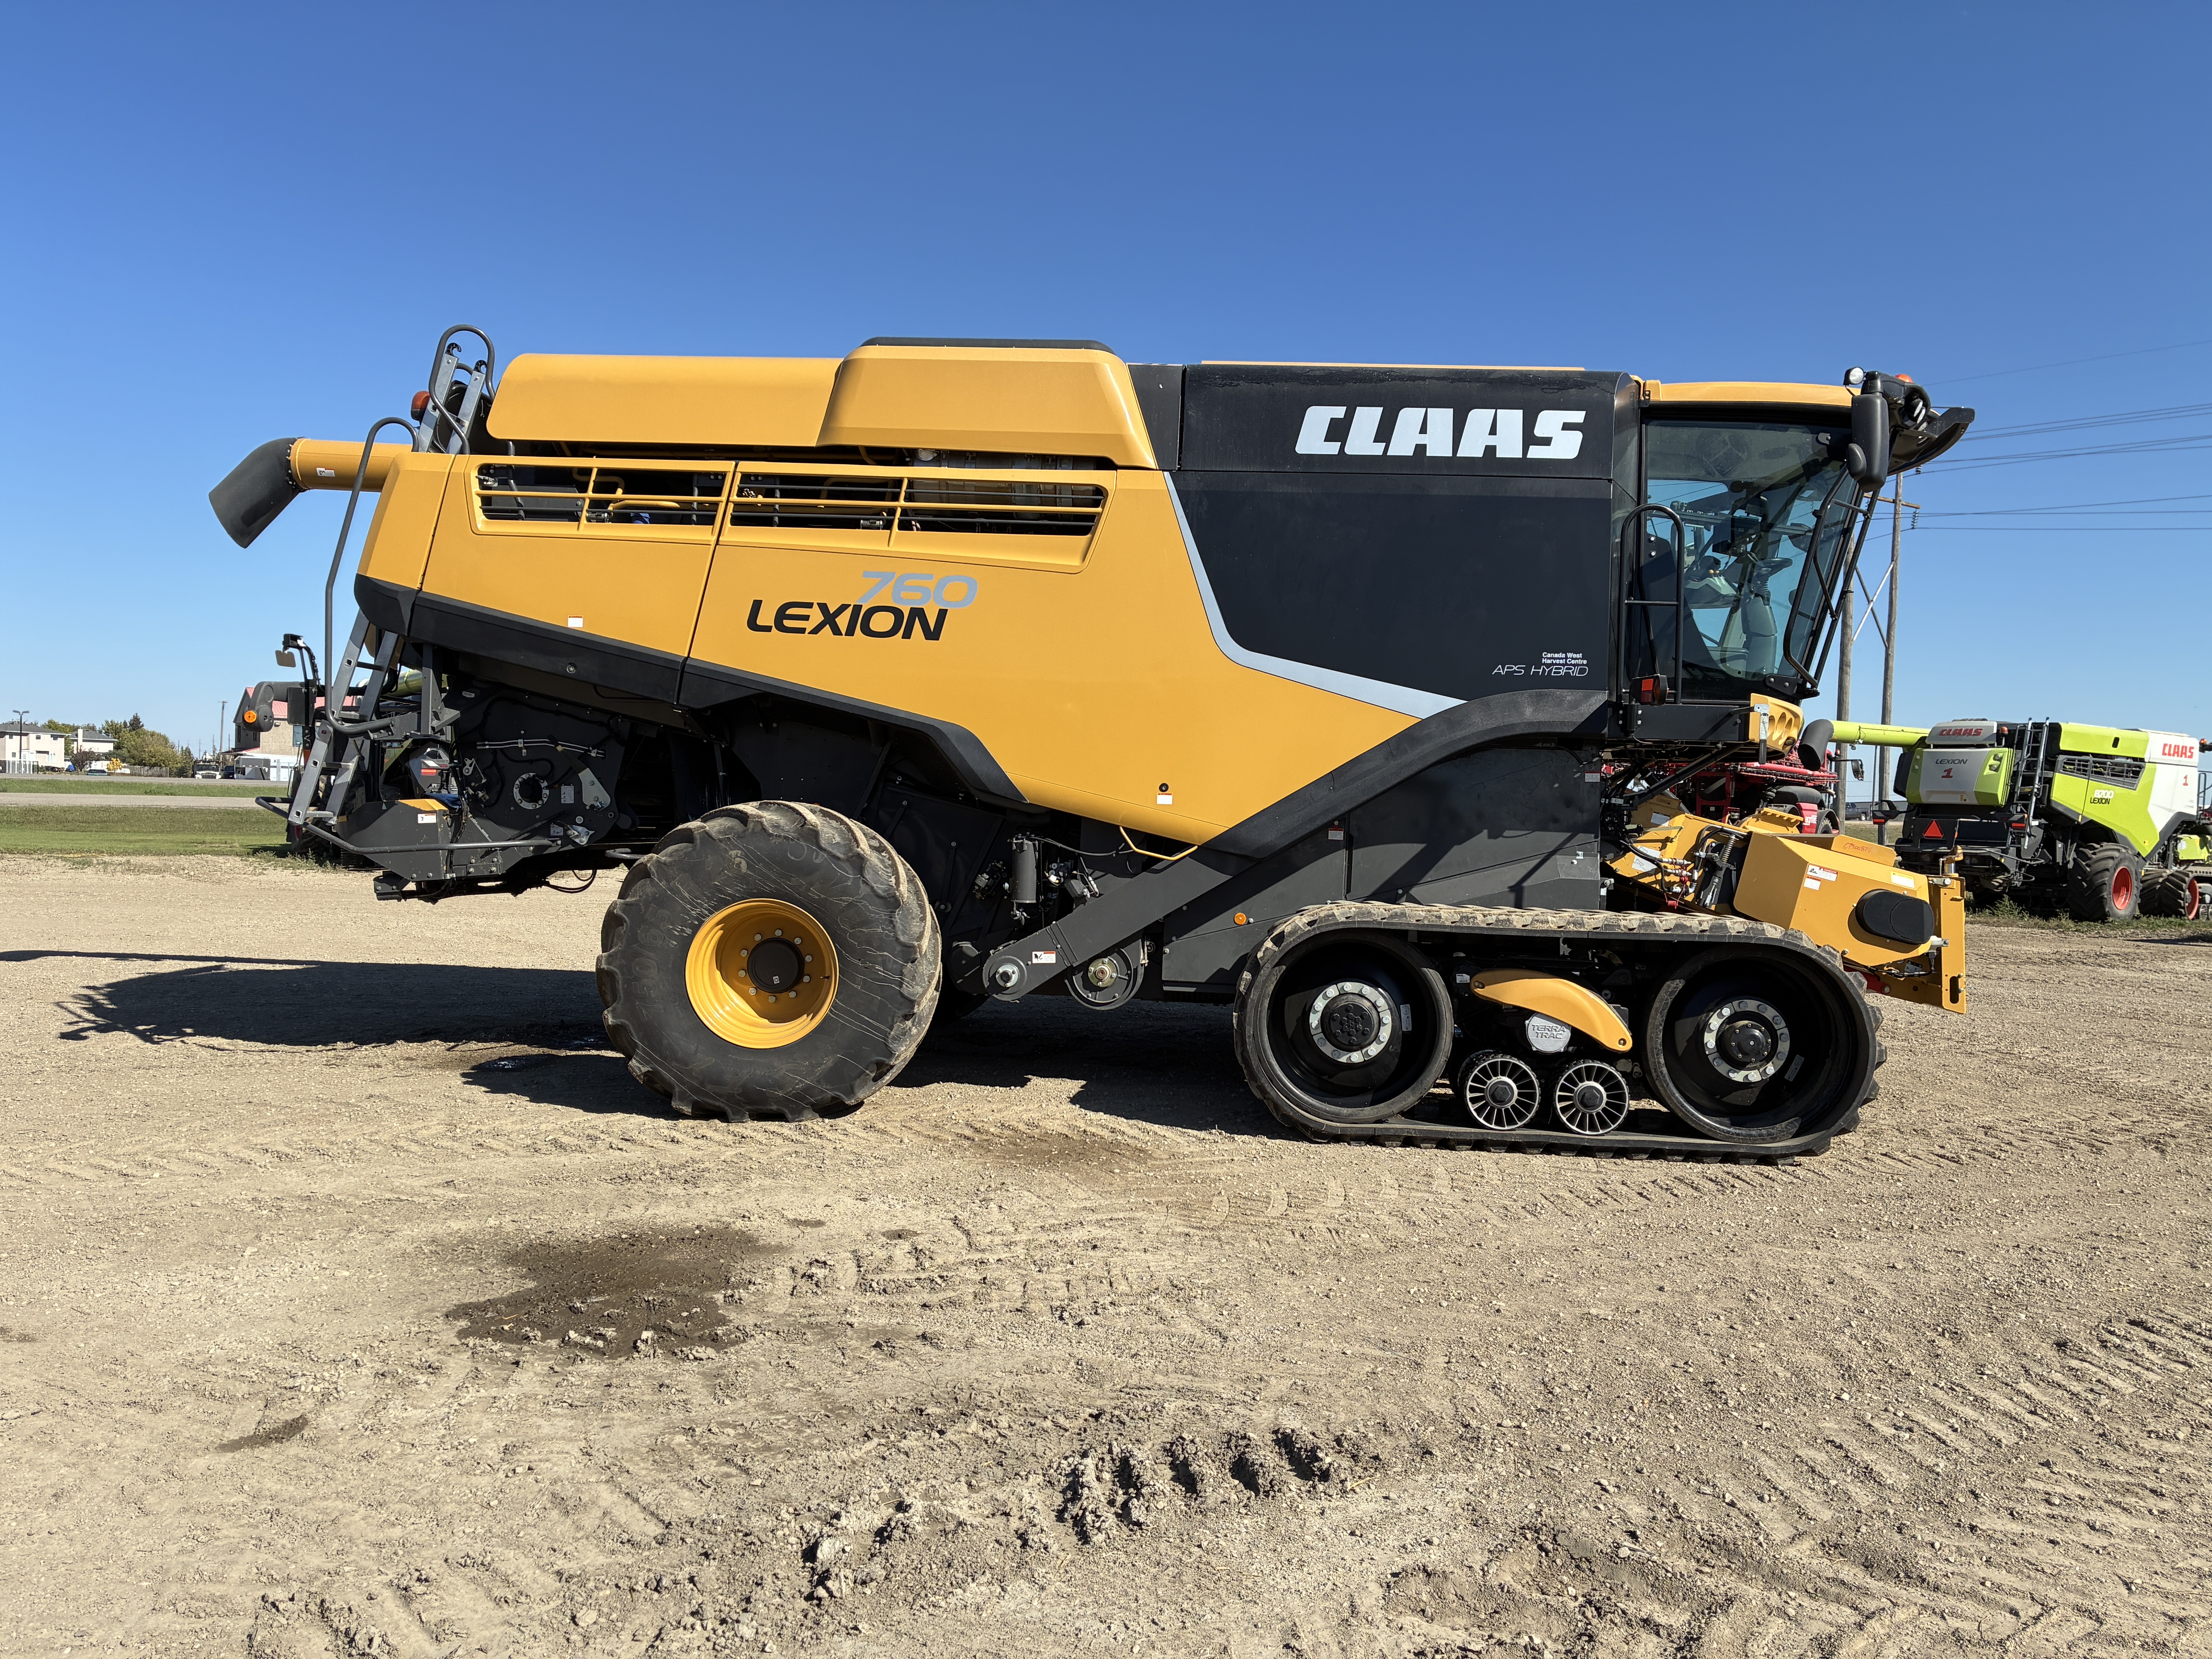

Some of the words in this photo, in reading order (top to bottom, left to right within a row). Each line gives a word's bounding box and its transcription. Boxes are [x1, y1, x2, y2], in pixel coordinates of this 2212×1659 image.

[1295, 406, 1586, 459] CLAAS
[857, 571, 979, 608] 760
[747, 599, 948, 641] LEXION
[1492, 665, 1526, 675] APS
[1530, 665, 1589, 677] HYBRID
[1939, 728, 1983, 736] CLAAS
[2162, 744, 2194, 758] CLAAS
[1941, 768, 1953, 778] 1
[2183, 775, 2188, 786] 1
[2094, 789, 2114, 799] 8700
[1532, 1024, 1566, 1032] TERRA
[1535, 1031, 1564, 1039] TRAC
